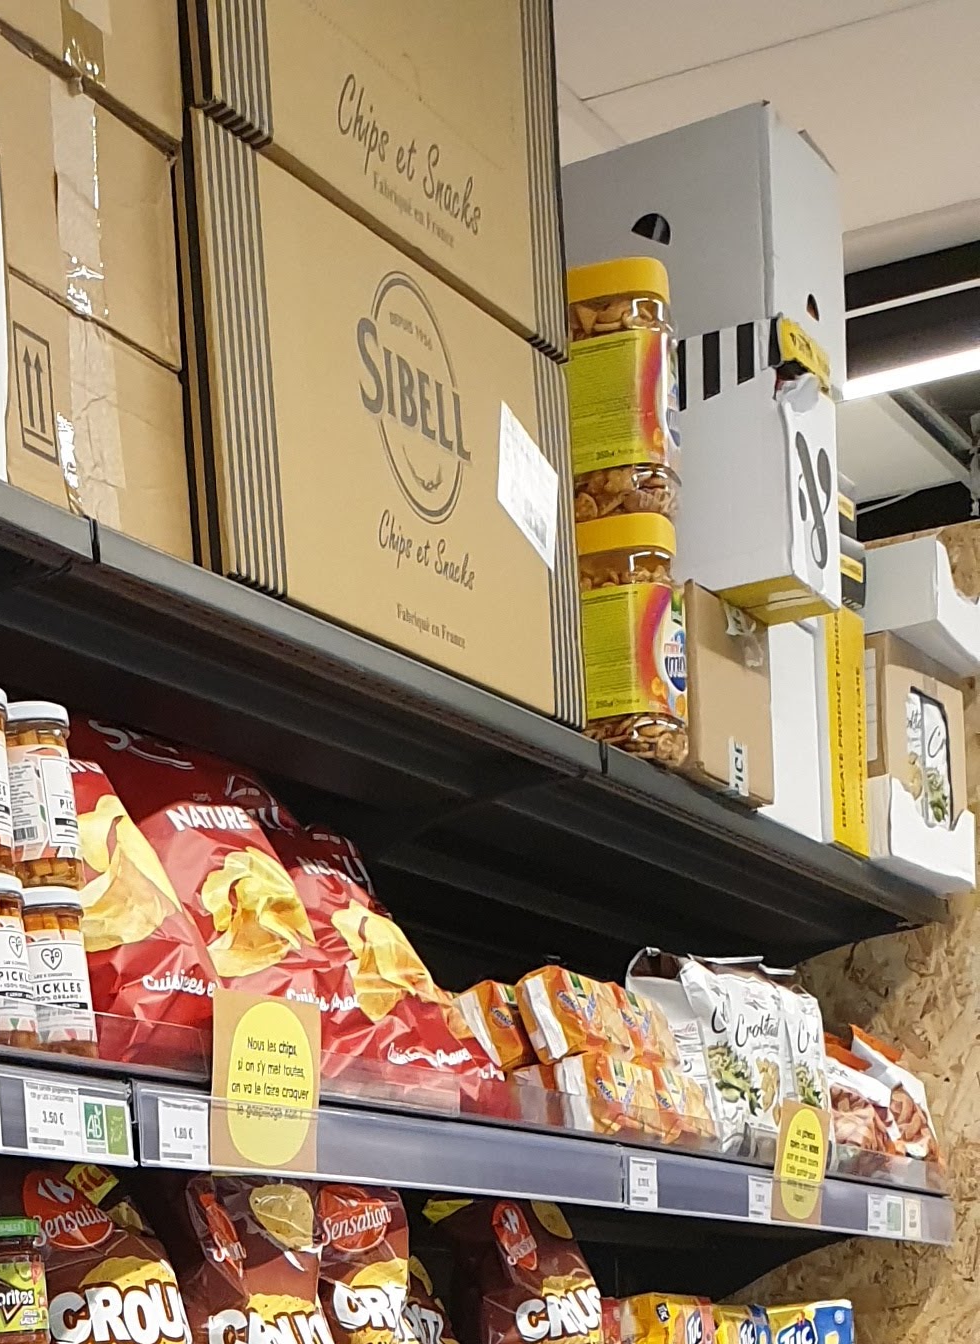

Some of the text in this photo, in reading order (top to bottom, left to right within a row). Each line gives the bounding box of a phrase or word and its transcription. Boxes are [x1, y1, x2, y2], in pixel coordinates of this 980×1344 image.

[338, 74, 481, 235] Chips et Snacks
[357, 317, 471, 462] SIBELL
[379, 509, 475, 590] Chips et Snacks
[167, 805, 253, 832] NATURE
[247, 1037, 265, 1051] Nous
[268, 1038, 277, 1052] les
[320, 1205, 392, 1246] Sensation
